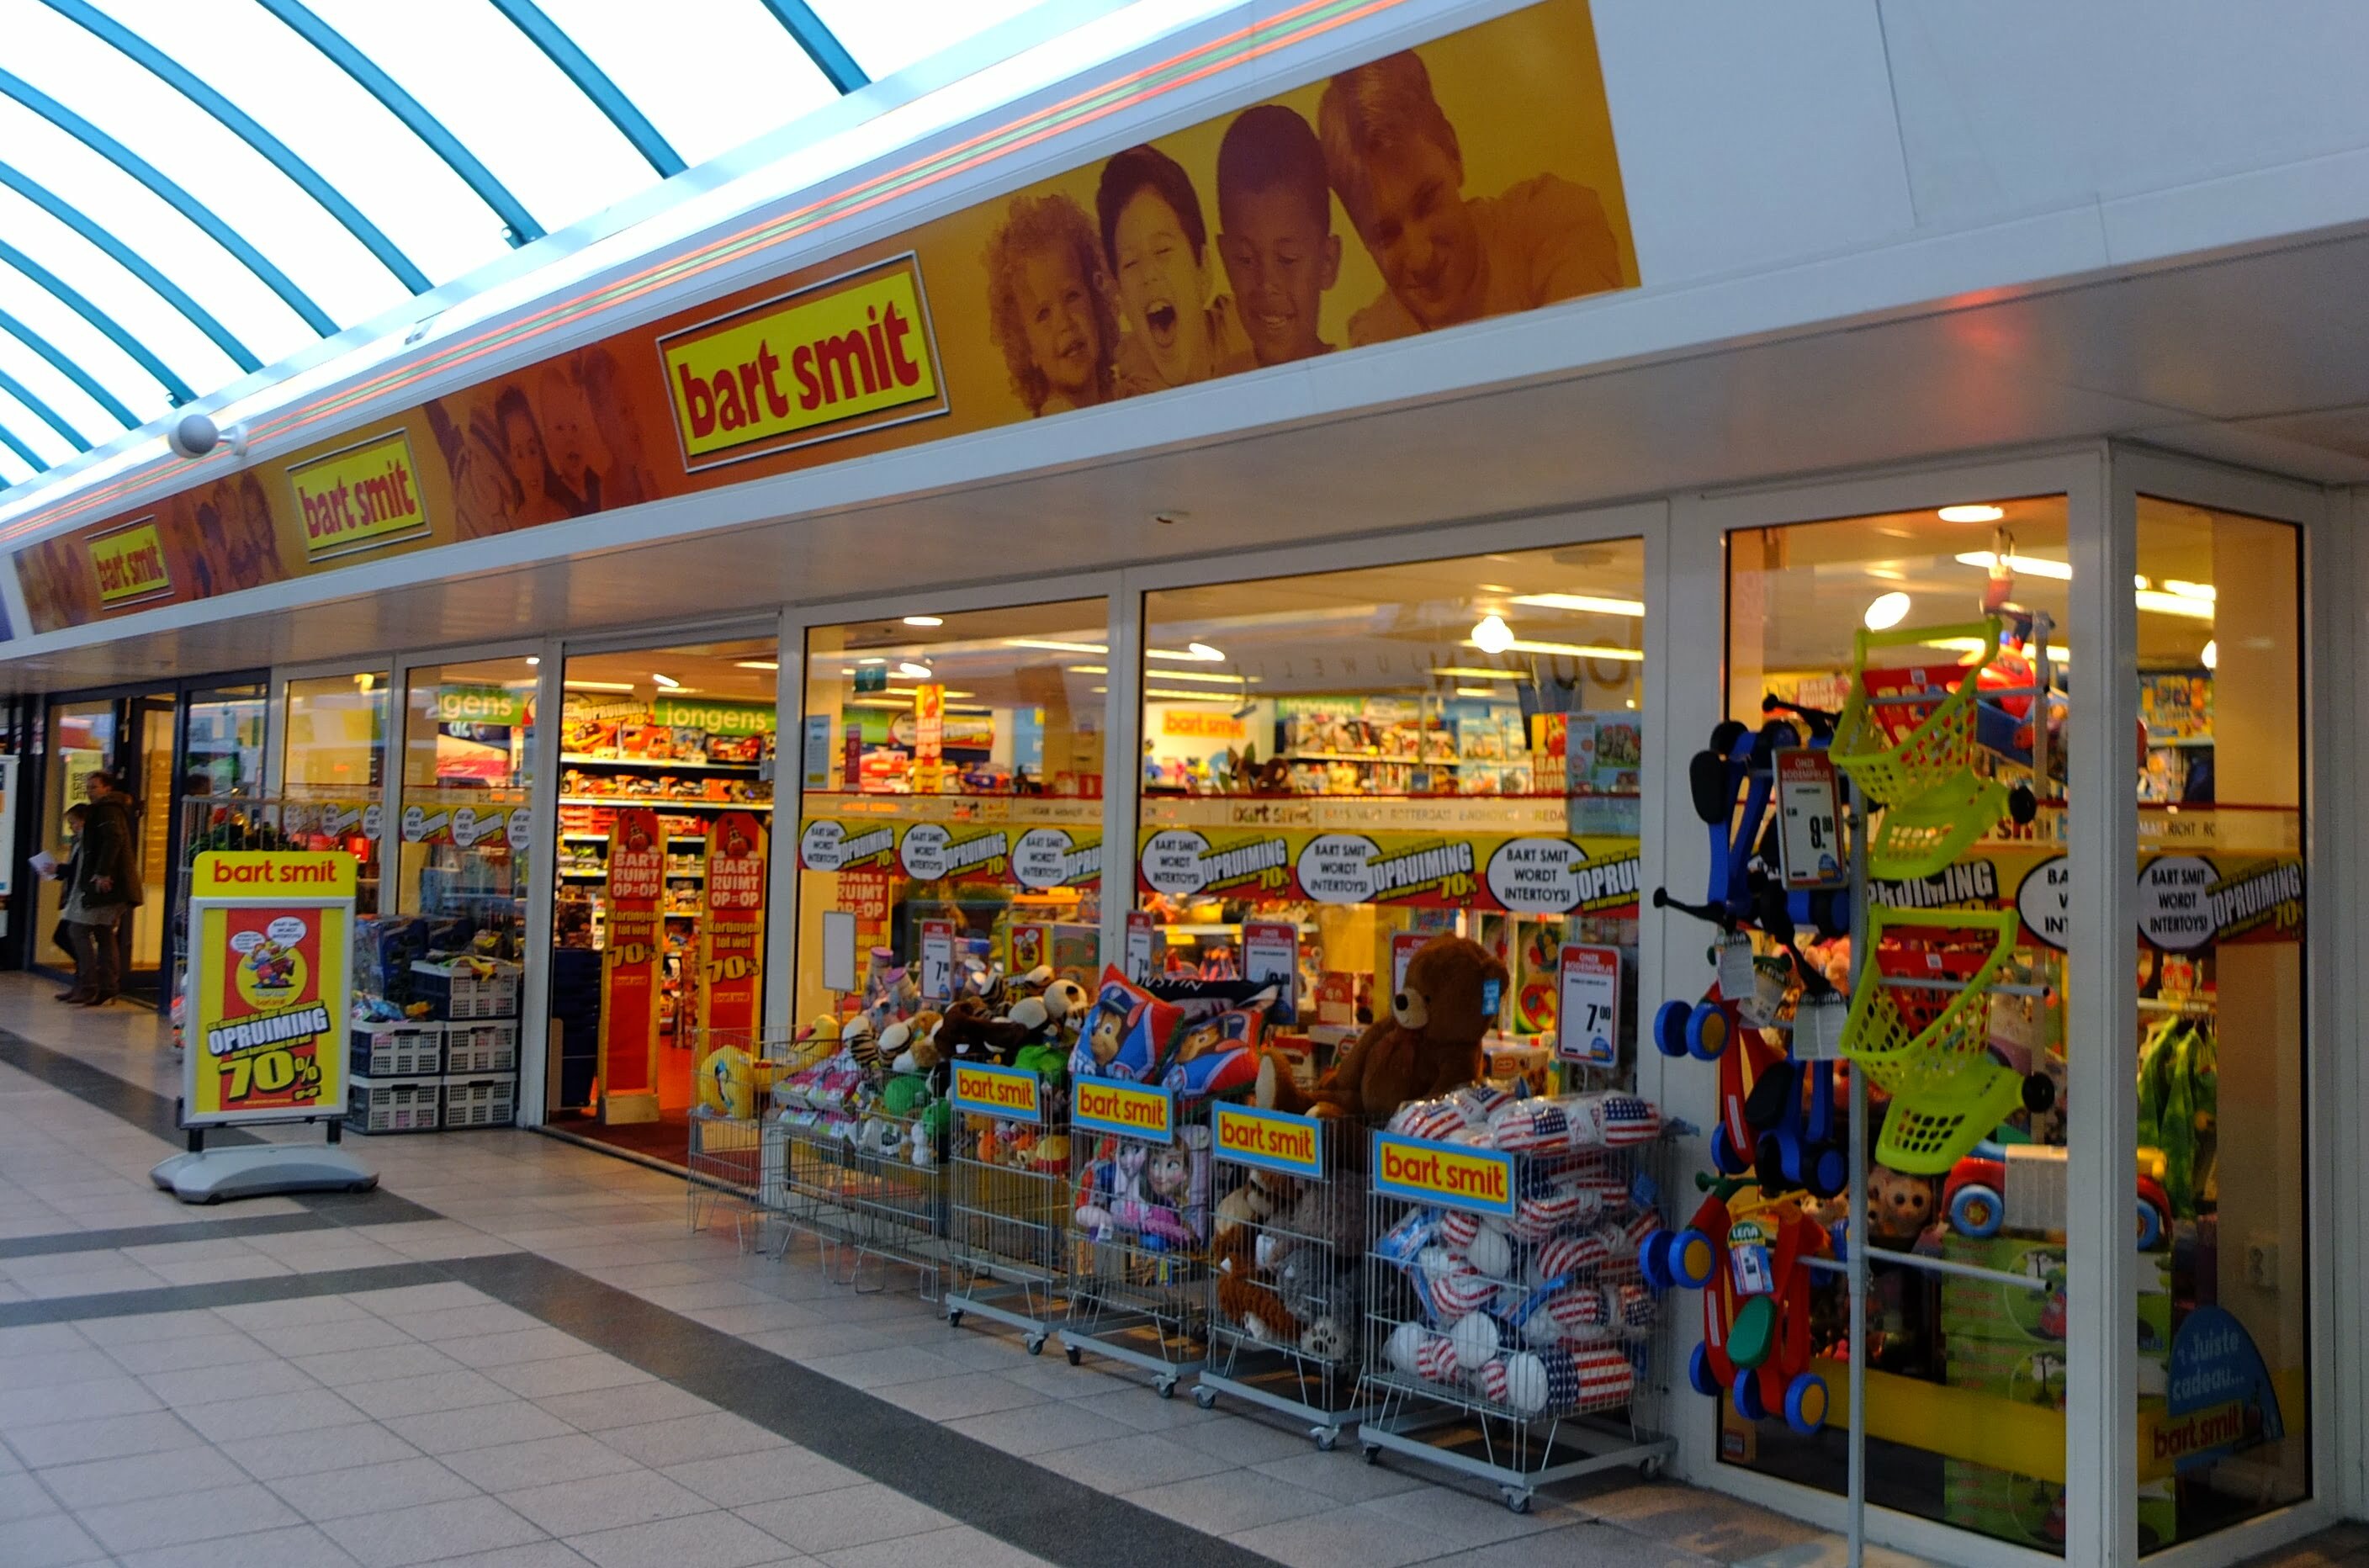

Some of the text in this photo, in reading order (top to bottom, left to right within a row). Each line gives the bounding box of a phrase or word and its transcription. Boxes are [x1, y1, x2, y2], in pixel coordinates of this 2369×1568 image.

[678, 299, 920, 439] bart smit
[298, 458, 417, 538] bart smit
[96, 538, 164, 591] bart smit
[1155, 840, 1199, 851] BART SMIT
[1315, 845, 1366, 856] BART SMIT
[1507, 848, 1568, 863] BART SMIT
[613, 853, 661, 867] BART
[713, 859, 761, 874] BART
[1159, 856, 1190, 867] WORDT
[1202, 838, 1287, 884] OPRUIMING
[1320, 862, 1358, 875] WORDT
[1373, 842, 1473, 892] OPRUIMING
[214, 859, 337, 883] bart smit
[613, 868, 660, 882] RUIMT
[1513, 869, 1557, 882] WORDT
[2151, 869, 2205, 887] BART SMIT
[712, 876, 759, 890] RUIMT
[2159, 893, 2197, 910] WORDT
[2212, 862, 2302, 928] OPRUIMING
[208, 1007, 330, 1055] OPRUIMING
[958, 1069, 1034, 1108] bart smit
[1079, 1087, 1165, 1127] bart smit
[1221, 1115, 1314, 1161] bart smit
[1384, 1146, 1505, 1199] bart smit
[1731, 1226, 1758, 1238] LENA
[2153, 1402, 2243, 1459] bart smit
